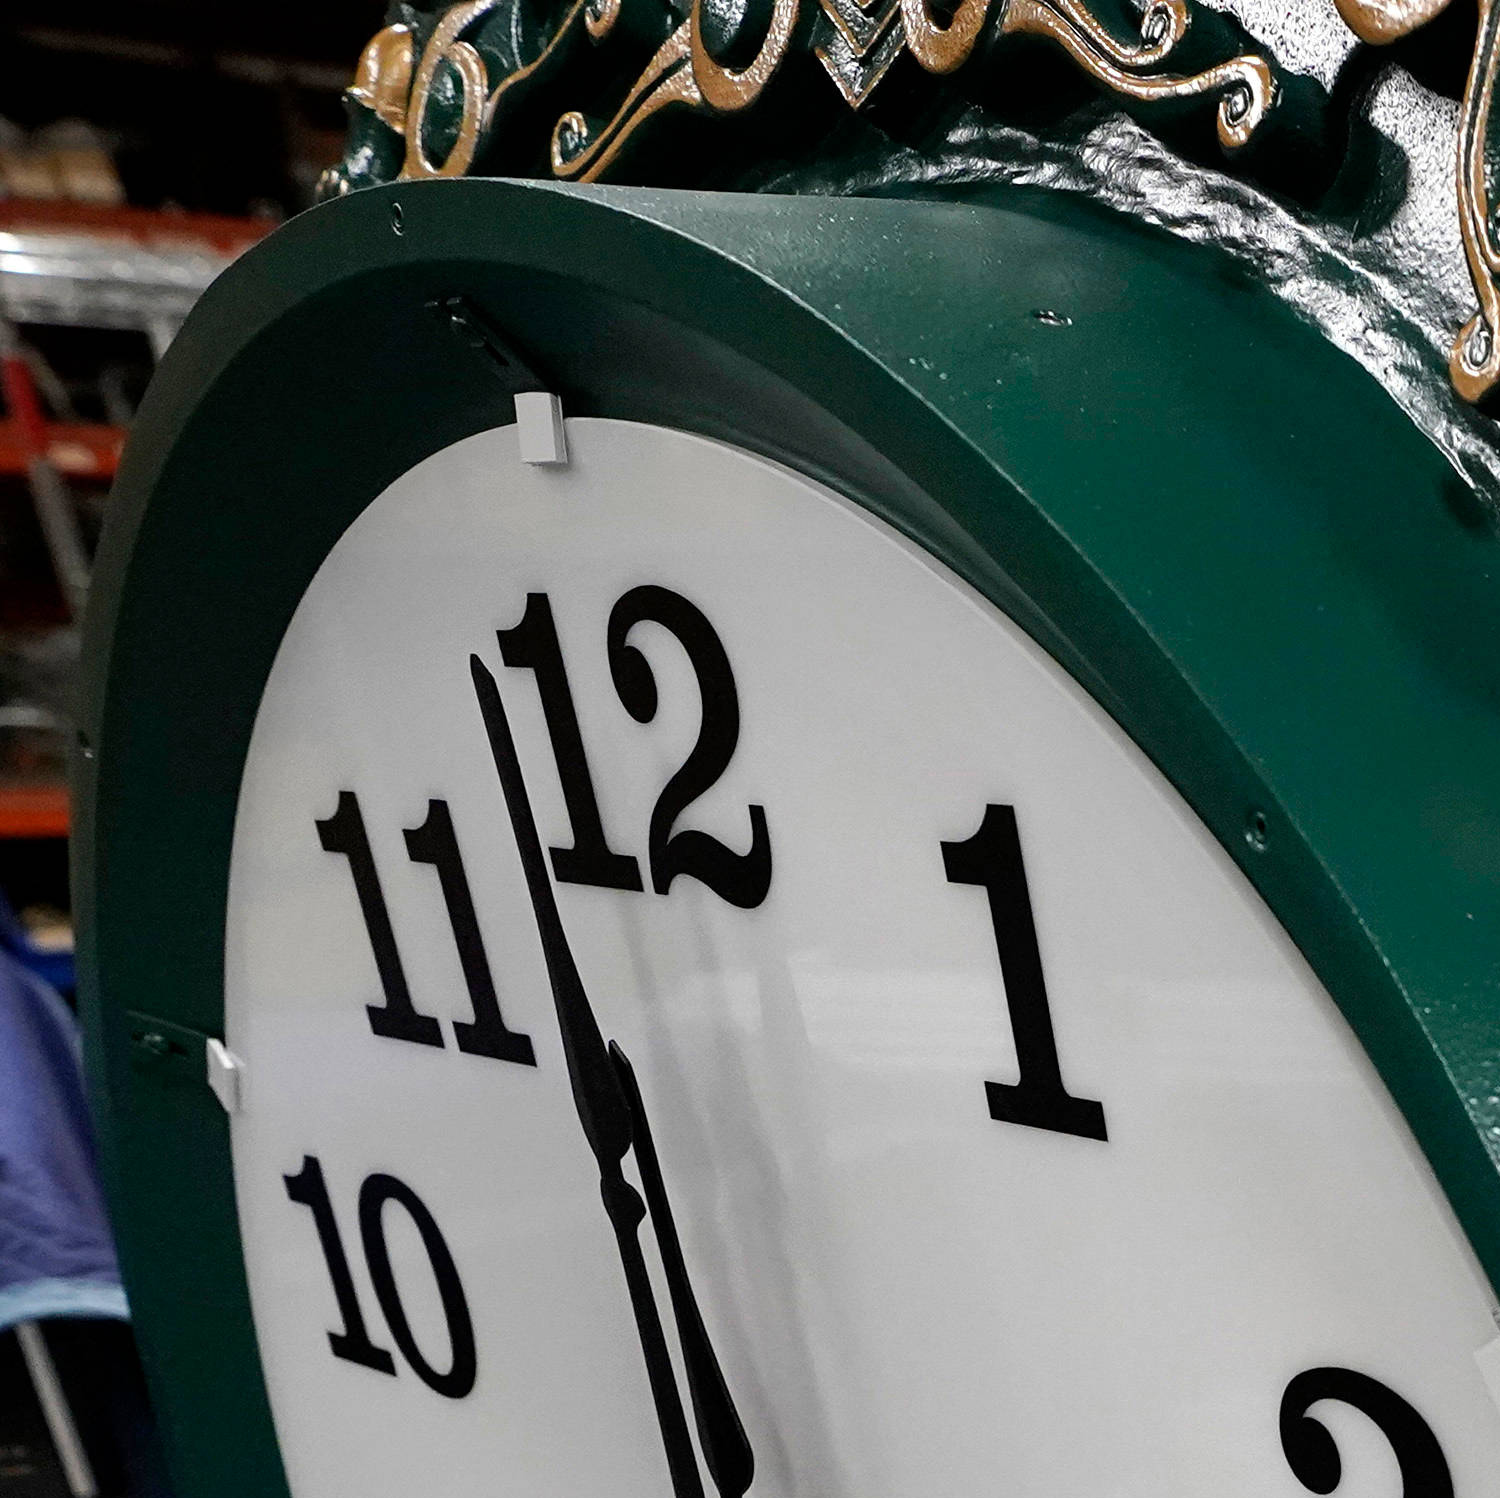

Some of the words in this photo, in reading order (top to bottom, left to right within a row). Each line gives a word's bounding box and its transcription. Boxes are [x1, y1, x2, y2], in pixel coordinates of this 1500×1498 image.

[495, 584, 773, 910] 12
[314, 789, 538, 1069] 11
[939, 803, 1109, 1143] 1
[281, 1154, 478, 1400] 10
